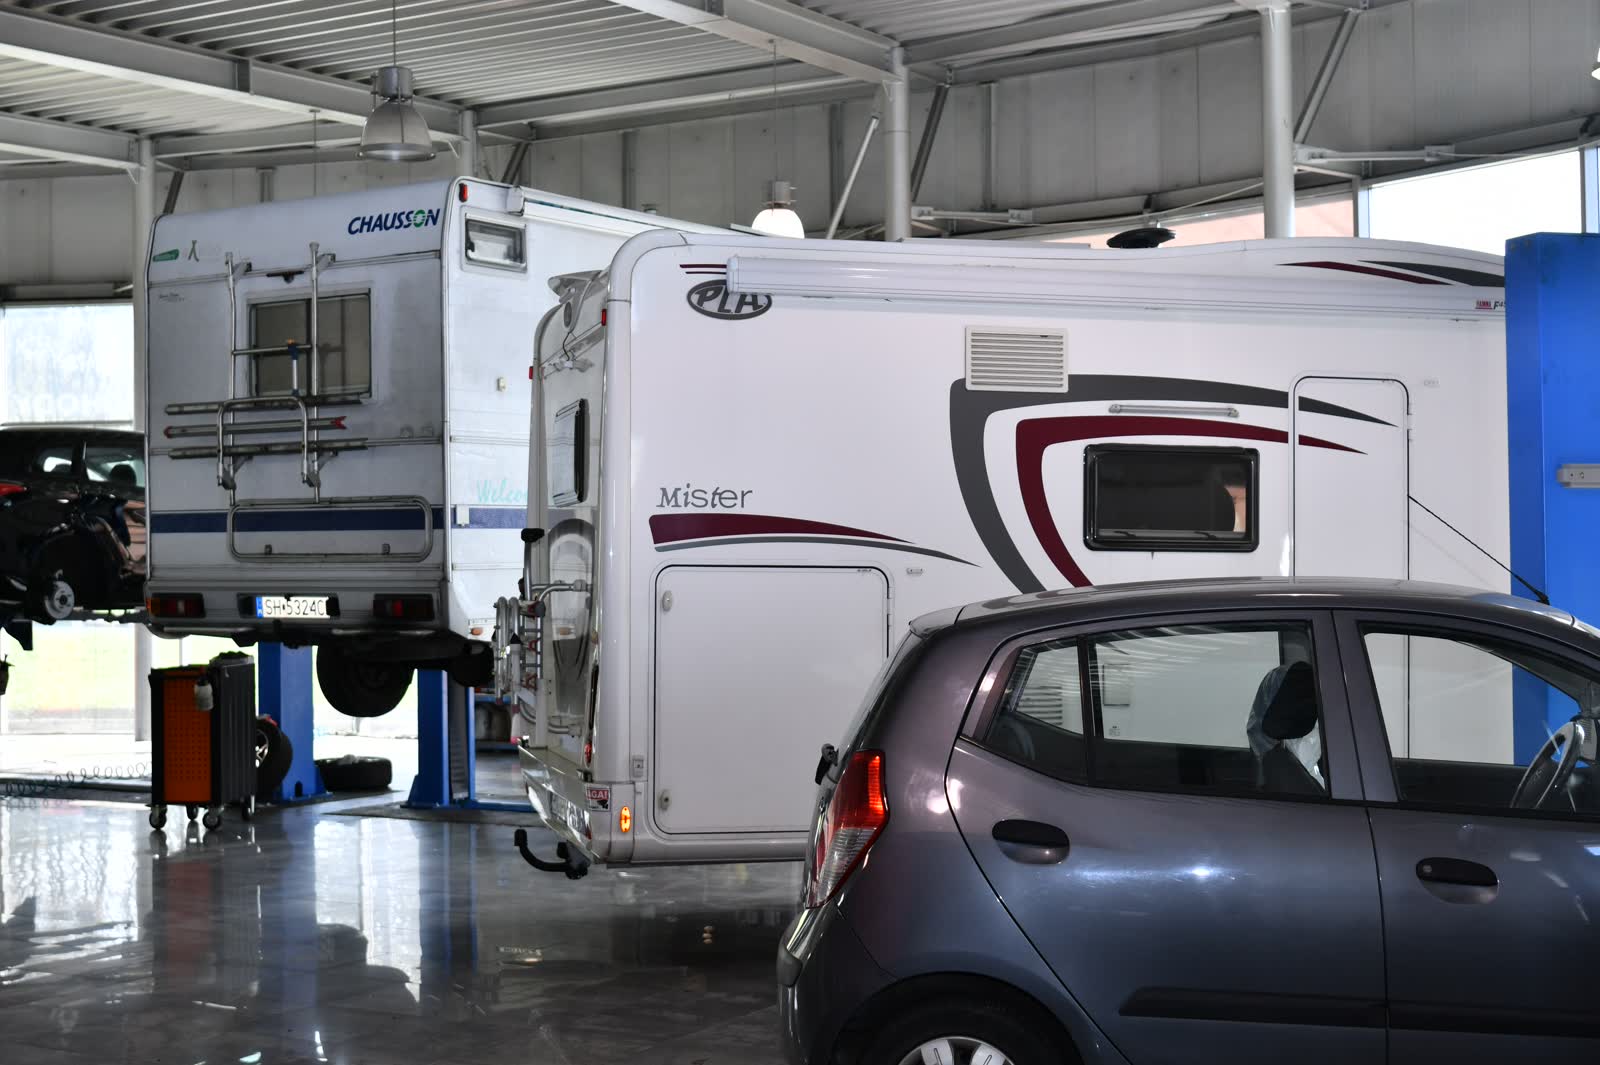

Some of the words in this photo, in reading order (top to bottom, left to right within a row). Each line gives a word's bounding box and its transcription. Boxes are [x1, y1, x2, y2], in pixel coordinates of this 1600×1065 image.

[347, 207, 440, 236] CHAUSSON
[694, 284, 766, 314] PLA
[476, 479, 527, 504] Welco
[656, 482, 753, 508] Mister
